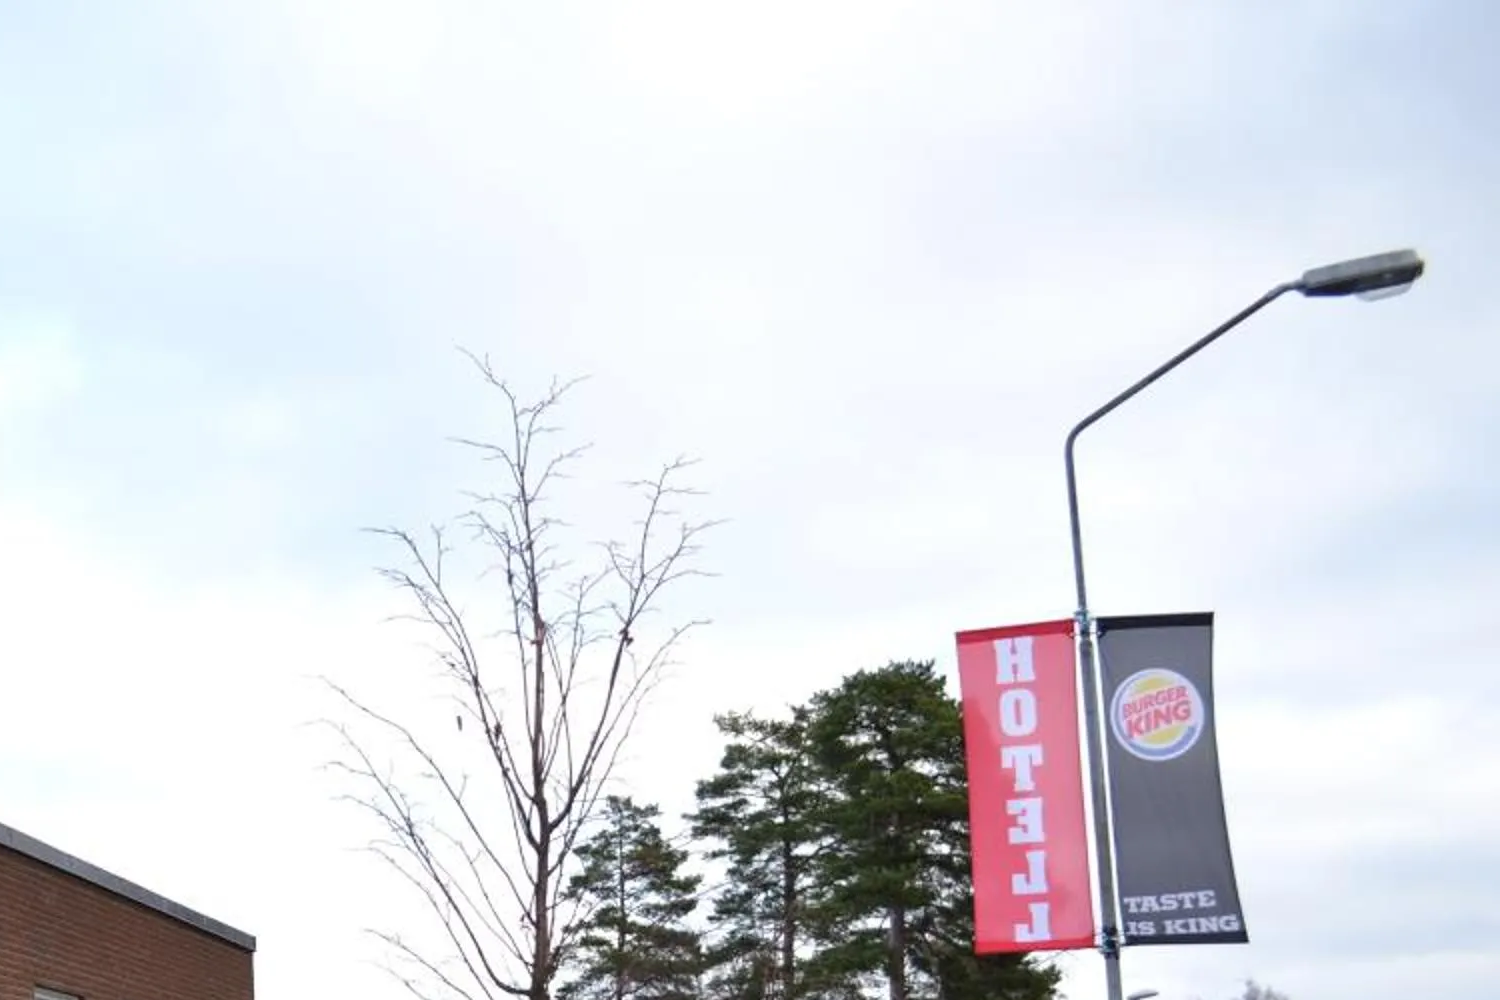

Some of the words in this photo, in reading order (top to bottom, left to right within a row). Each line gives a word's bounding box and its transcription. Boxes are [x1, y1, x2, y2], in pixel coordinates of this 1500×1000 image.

[1123, 685, 1188, 719] BURGER
[1126, 700, 1191, 738] KING
[1123, 890, 1217, 913] TASTE
[1127, 921, 1156, 936] IS
[1164, 914, 1240, 935] KING
